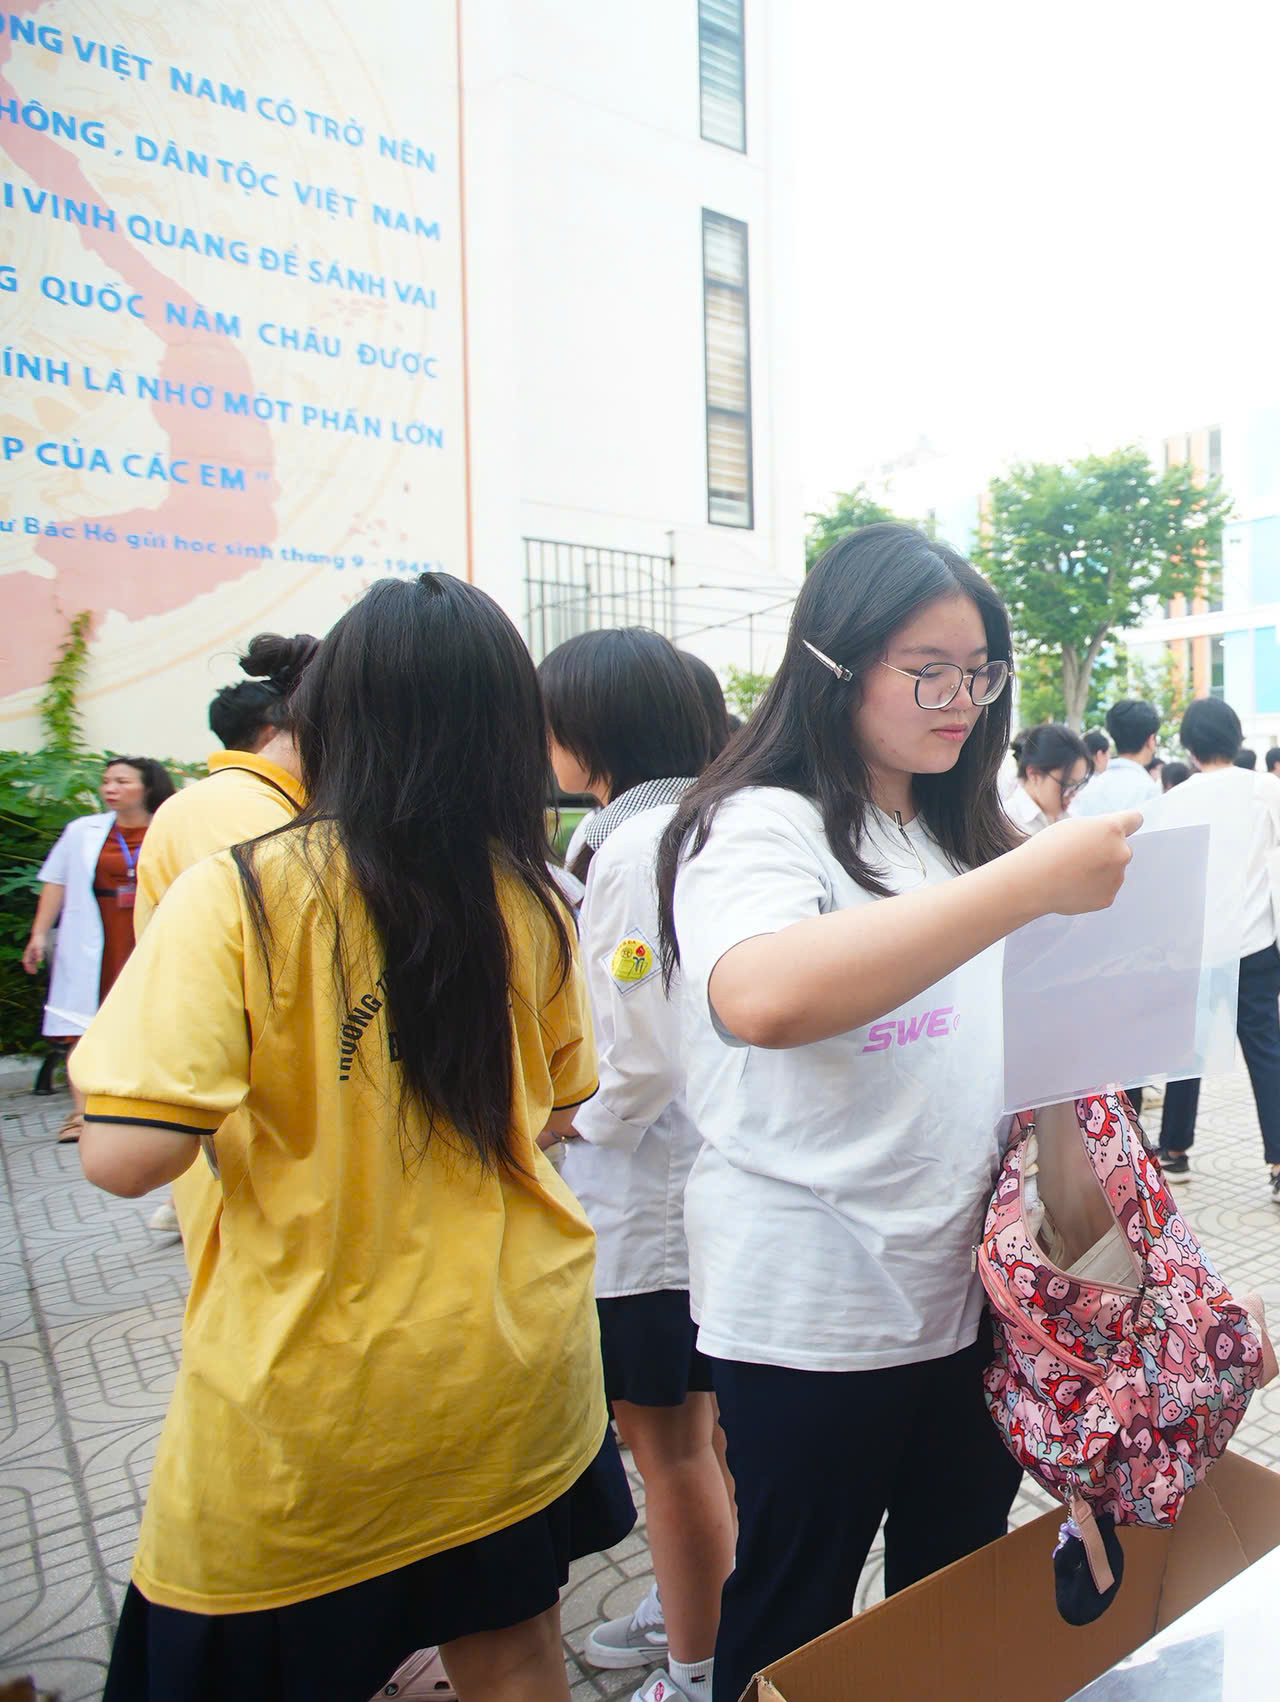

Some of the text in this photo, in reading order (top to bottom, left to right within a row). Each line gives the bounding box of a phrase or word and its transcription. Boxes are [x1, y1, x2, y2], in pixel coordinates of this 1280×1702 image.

[0, 12, 63, 54] NG
[72, 33, 152, 81] VIỆT
[170, 66, 247, 112] NAM
[256, 97, 297, 127] CÓ
[378, 135, 436, 173] NÊN
[135, 134, 208, 178] DÂN
[216, 157, 280, 197] TỘC
[293, 179, 357, 221] VIỆT
[372, 203, 440, 241] NAM
[22, 186, 116, 233] VINH
[127, 214, 250, 265] QUANG
[308, 258, 386, 298] SÁNH
[394, 279, 437, 310] VAI
[3, 346, 70, 387] ÍNH
[83, 365, 125, 396] LÀ
[40, 275, 145, 319] QUỐC
[258, 322, 341, 358] CHÂU
[356, 342, 439, 381] ĐƯỢC
[36, 437, 112, 475] CỦA
[121, 452, 189, 485] CÁC
[200, 464, 246, 491] EM
[862, 1006, 960, 1053] SWE
